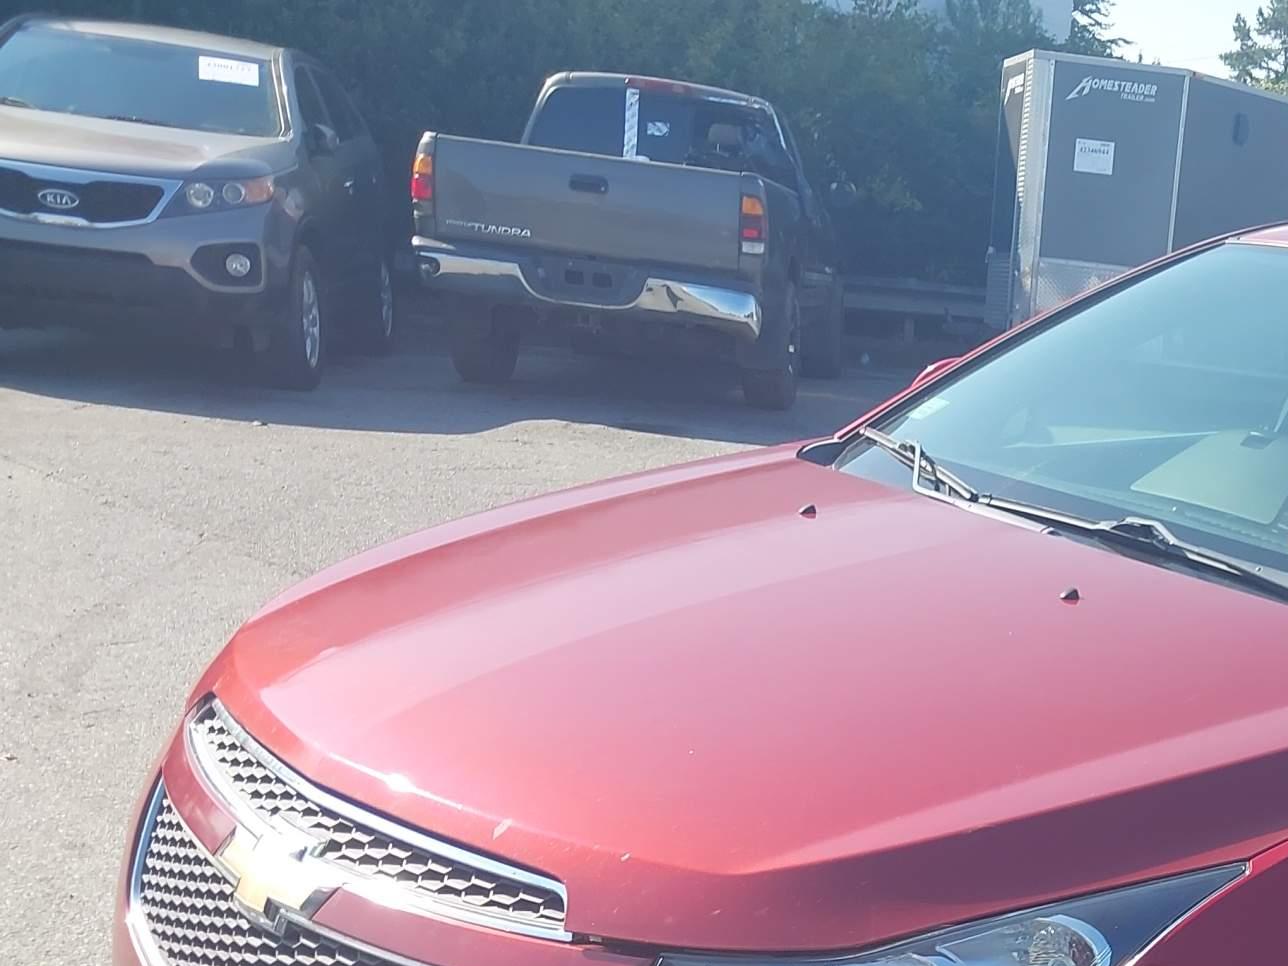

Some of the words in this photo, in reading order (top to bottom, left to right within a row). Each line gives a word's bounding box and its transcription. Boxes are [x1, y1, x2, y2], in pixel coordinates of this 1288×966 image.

[1065, 75, 1158, 100] HOMESTEADER
[46, 193, 72, 206] KIA
[472, 222, 532, 238] TUNDRA
